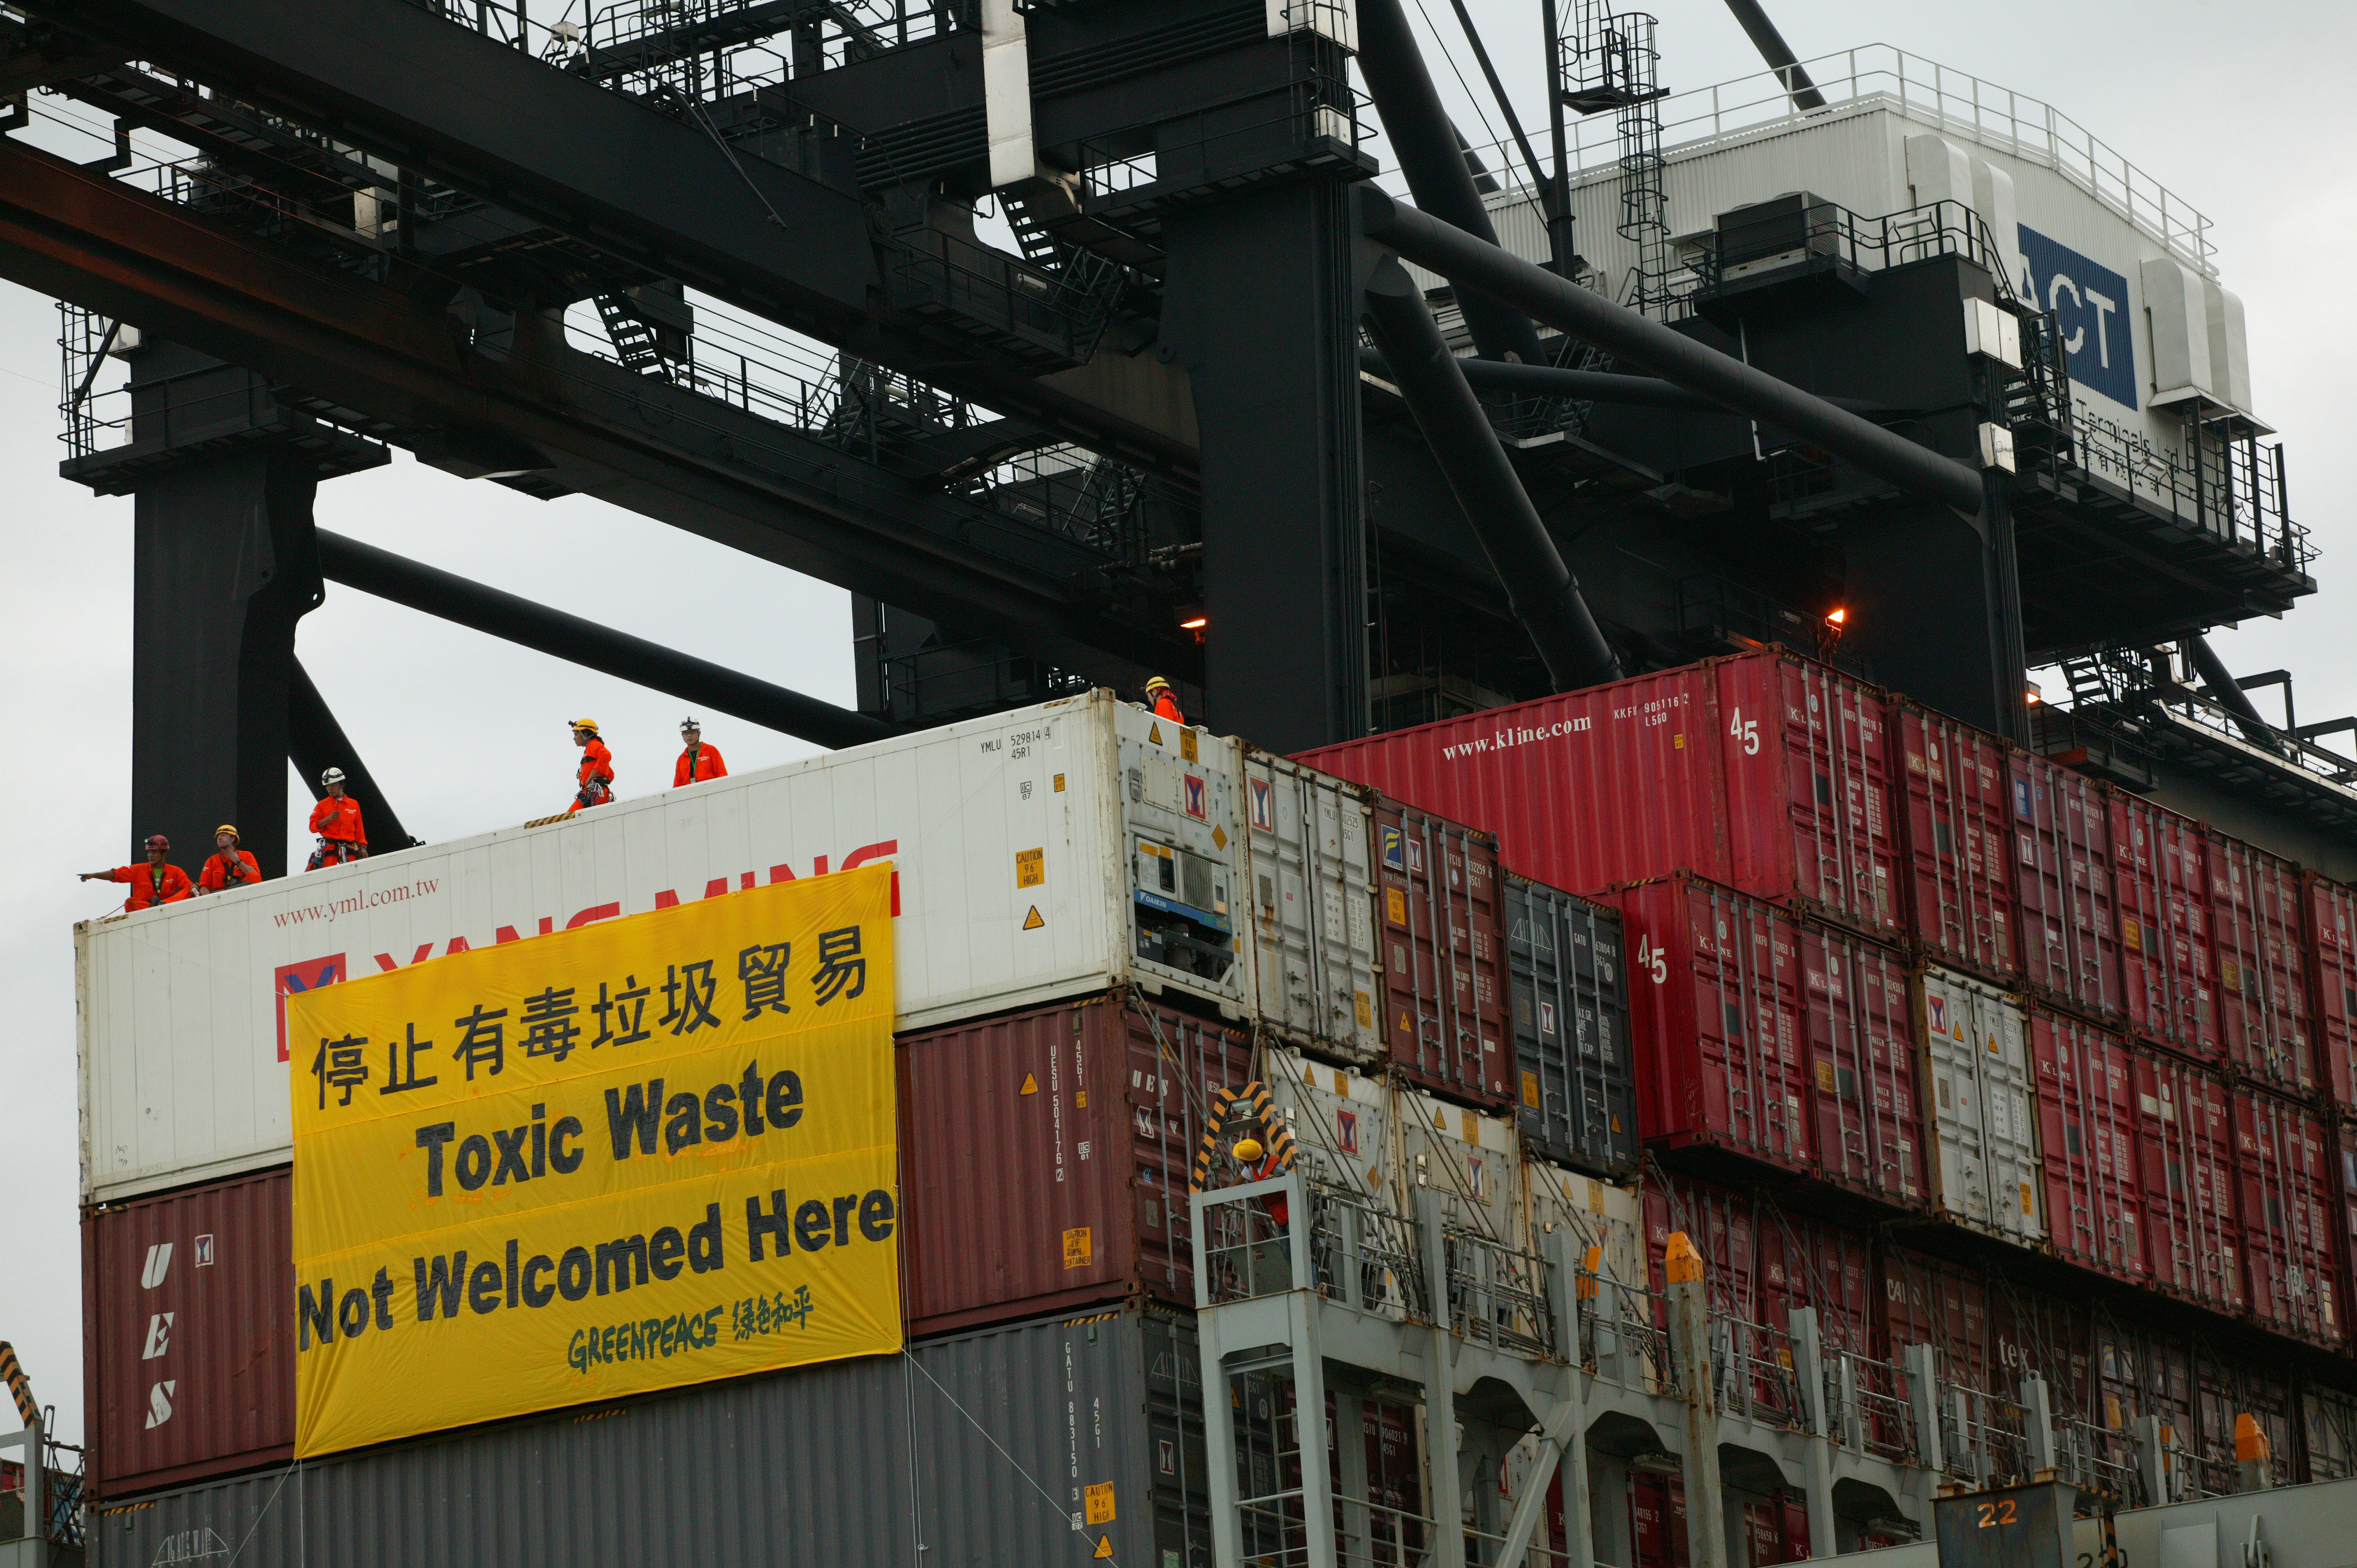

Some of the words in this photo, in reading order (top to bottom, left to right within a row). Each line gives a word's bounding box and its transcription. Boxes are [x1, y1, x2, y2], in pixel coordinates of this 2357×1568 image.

[2076, 398, 2150, 456] Terminals
[1614, 706, 1637, 720] KKFU
[1645, 696, 1679, 714] 905116
[1683, 692, 1689, 705] 2
[1790, 707, 1800, 721] K
[1801, 714, 1821, 730] LNE
[1844, 708, 1856, 722] KKFU
[1862, 716, 1876, 731] 05116
[981, 739, 1001, 754] YMLU
[1011, 729, 1040, 746] 529814
[1045, 727, 1051, 739] 4
[1442, 715, 1591, 760] www.kline.com
[1731, 707, 1760, 756] 45
[1011, 746, 1030, 760] 45R1
[1963, 757, 1975, 770] KKFU
[1912, 757, 1920, 770] K
[1921, 763, 1941, 778] LNE
[1022, 792, 1031, 800] 87
[1323, 806, 1336, 821] YMLU
[1342, 813, 1358, 828] 02525
[2087, 818, 2095, 830] 5G1
[1016, 850, 1043, 863] CAUTION
[1449, 853, 1462, 867] FCIU
[2119, 845, 2127, 859] K
[2128, 852, 2147, 866] LNE
[2168, 843, 2180, 856] KKFU
[1384, 858, 1402, 870] FLORENS
[1024, 873, 1038, 885] HIGH
[2215, 879, 2224, 892] K
[2225, 885, 2243, 901] LNE
[274, 879, 440, 928] www.yml.com.tw
[1145, 895, 1167, 908] DAIKIN
[1574, 932, 1586, 946] GATU
[1595, 941, 1611, 956] 63804
[1699, 936, 1708, 949] K
[1710, 942, 1732, 958] LNE
[1755, 933, 1768, 948] KKFU
[1774, 941, 1788, 955] 12453
[2322, 928, 2331, 941] K
[2332, 934, 2349, 948] LNE
[1596, 954, 1605, 968] 5G1
[1638, 934, 1667, 984] 45
[1810, 972, 1820, 986] K
[1821, 979, 1842, 994] LNE
[1867, 972, 1880, 986] KKFU
[1887, 978, 1901, 993] 02430
[1888, 993, 1897, 1005] 5G0
[311, 924, 866, 1110] 停止有毒垃圾貿易
[1989, 1015, 1999, 1028] YMLU
[2004, 1021, 2017, 1035] 50318
[2006, 1035, 2014, 1046] 5G1
[2042, 1061, 2050, 1073] K
[2053, 1068, 2072, 1081] LNE
[2091, 1058, 2102, 1072] KKFU
[1133, 1070, 1169, 1097] UES
[1207, 1080, 1220, 1094] UESU
[416, 1102, 583, 1197] Toxic
[604, 1059, 804, 1161] Waste
[1053, 1095, 1062, 1164] 504176
[2243, 1137, 2252, 1149] K
[2253, 1142, 2272, 1156] LNE
[1056, 1168, 1064, 1182] 2
[1656, 1227, 1665, 1240] K
[299, 1265, 394, 1351] Not
[414, 1203, 723, 1322] Welcomed
[746, 1188, 895, 1262] Here
[1770, 1265, 1780, 1280] K
[1782, 1272, 1801, 1287] LNE
[568, 1305, 724, 1374] GREENPEACE
[1999, 1333, 2029, 1371] tex
[1249, 1380, 1259, 1394] 5G1
[1069, 1402, 1078, 1478] 883150
[1072, 1487, 1079, 1501] 3
[1085, 1482, 1113, 1498] CAUTION
[1094, 1509, 1109, 1523] HIGH
[1636, 1507, 1652, 1522] 48155
[1977, 1499, 2018, 1528] 22
[1757, 1528, 1772, 1542] 58658
